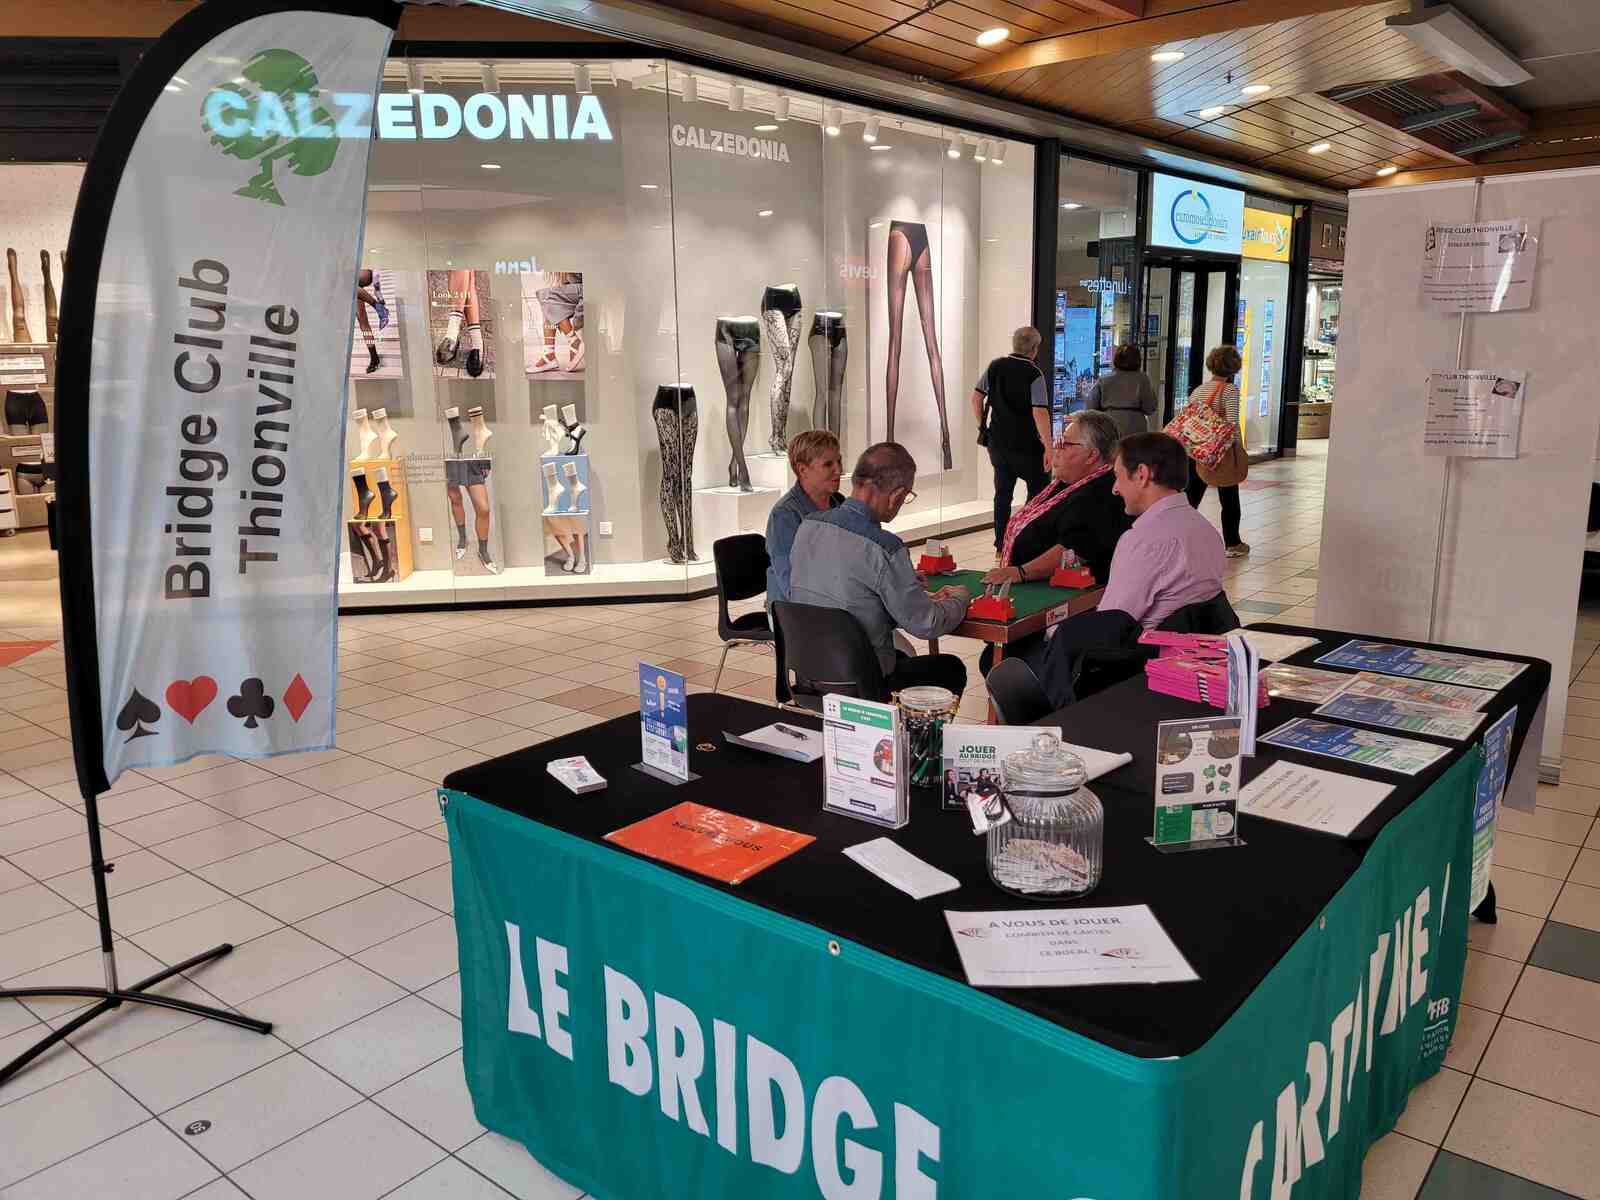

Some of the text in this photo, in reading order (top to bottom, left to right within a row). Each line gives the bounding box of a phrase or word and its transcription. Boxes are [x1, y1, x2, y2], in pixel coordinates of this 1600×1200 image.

[206, 88, 613, 140] CALZEDONIA
[672, 124, 790, 162] CALZEDONIA
[1473, 224, 1513, 233] THIONVILLE
[164, 259, 230, 599] Bridge Club
[238, 305, 299, 574] Thionville
[959, 745, 997, 754] JOUER
[1002, 918, 1047, 929] VOUS
[1050, 917, 1069, 927] DE
[1073, 916, 1122, 926] JOUER
[504, 920, 574, 1061] LE
[603, 964, 940, 1200] BRIDGE
